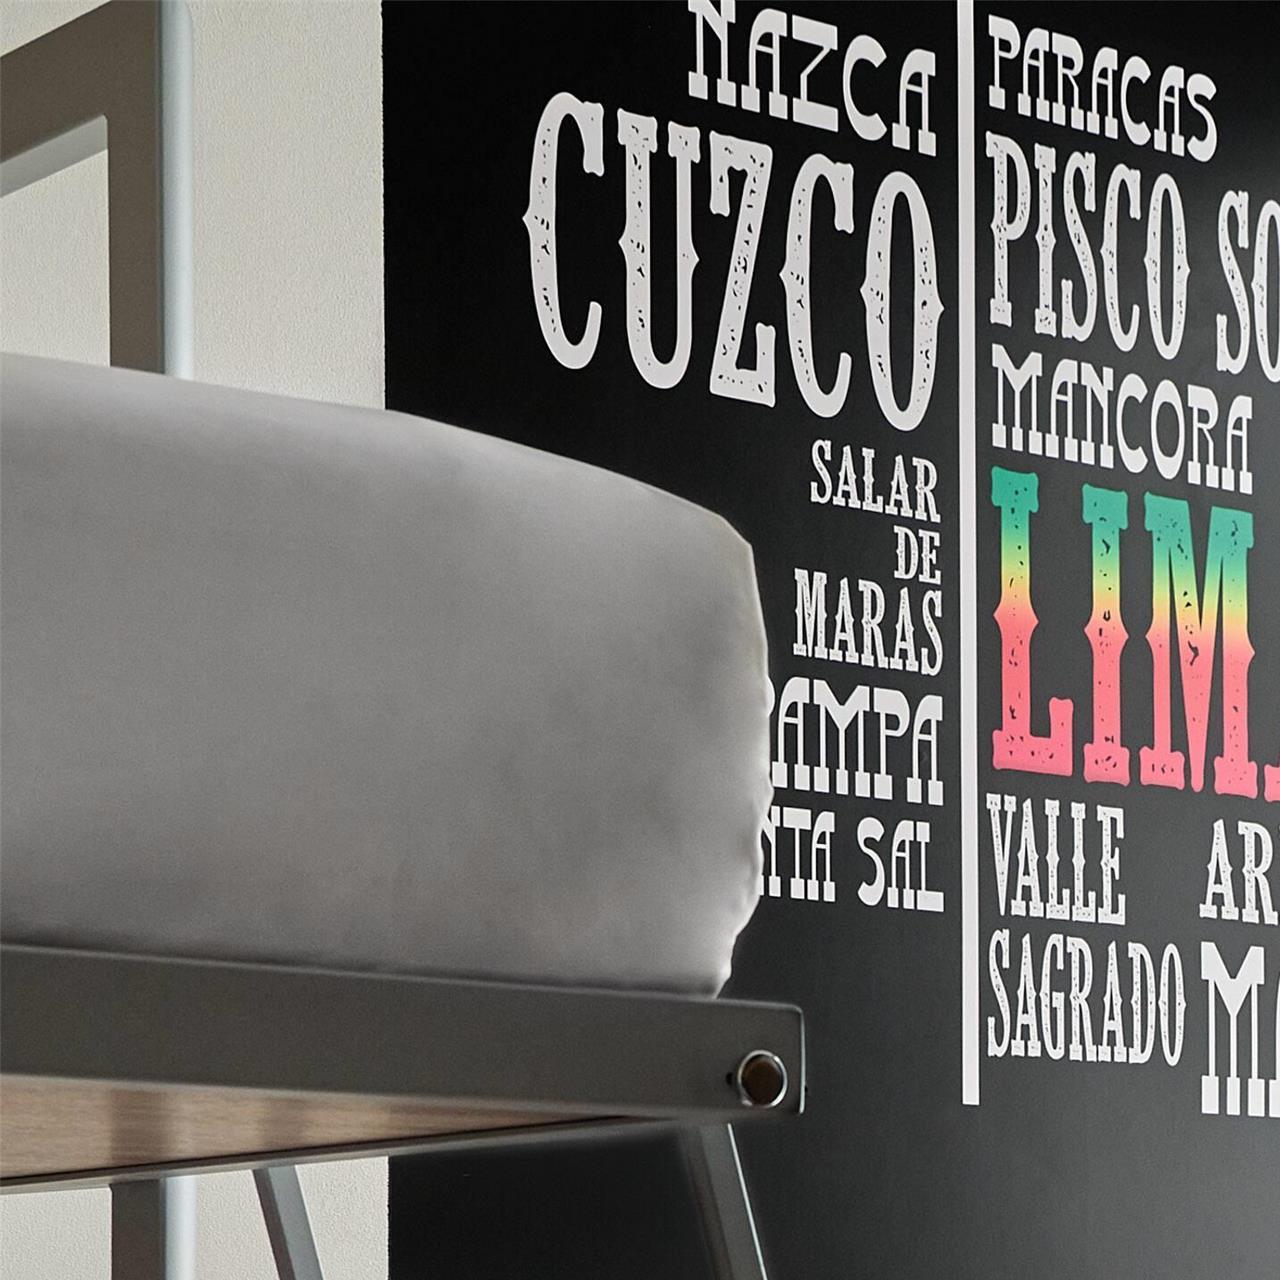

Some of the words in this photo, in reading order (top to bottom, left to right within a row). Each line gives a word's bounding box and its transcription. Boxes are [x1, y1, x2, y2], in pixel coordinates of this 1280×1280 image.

[688, 0, 937, 156] NAZCA
[988, 14, 1218, 162] PARACAS
[522, 91, 945, 432] CUZCO
[985, 131, 1191, 360] PISCO
[810, 439, 942, 523] SALAR
[991, 344, 1253, 495] MANCORA
[793, 568, 944, 676] MARAS
[893, 525, 942, 584] DE
[766, 676, 944, 807] AMPA
[857, 816, 945, 913] SAL
[986, 793, 1126, 926] VALLE
[987, 928, 1187, 1067] SAGRADO
